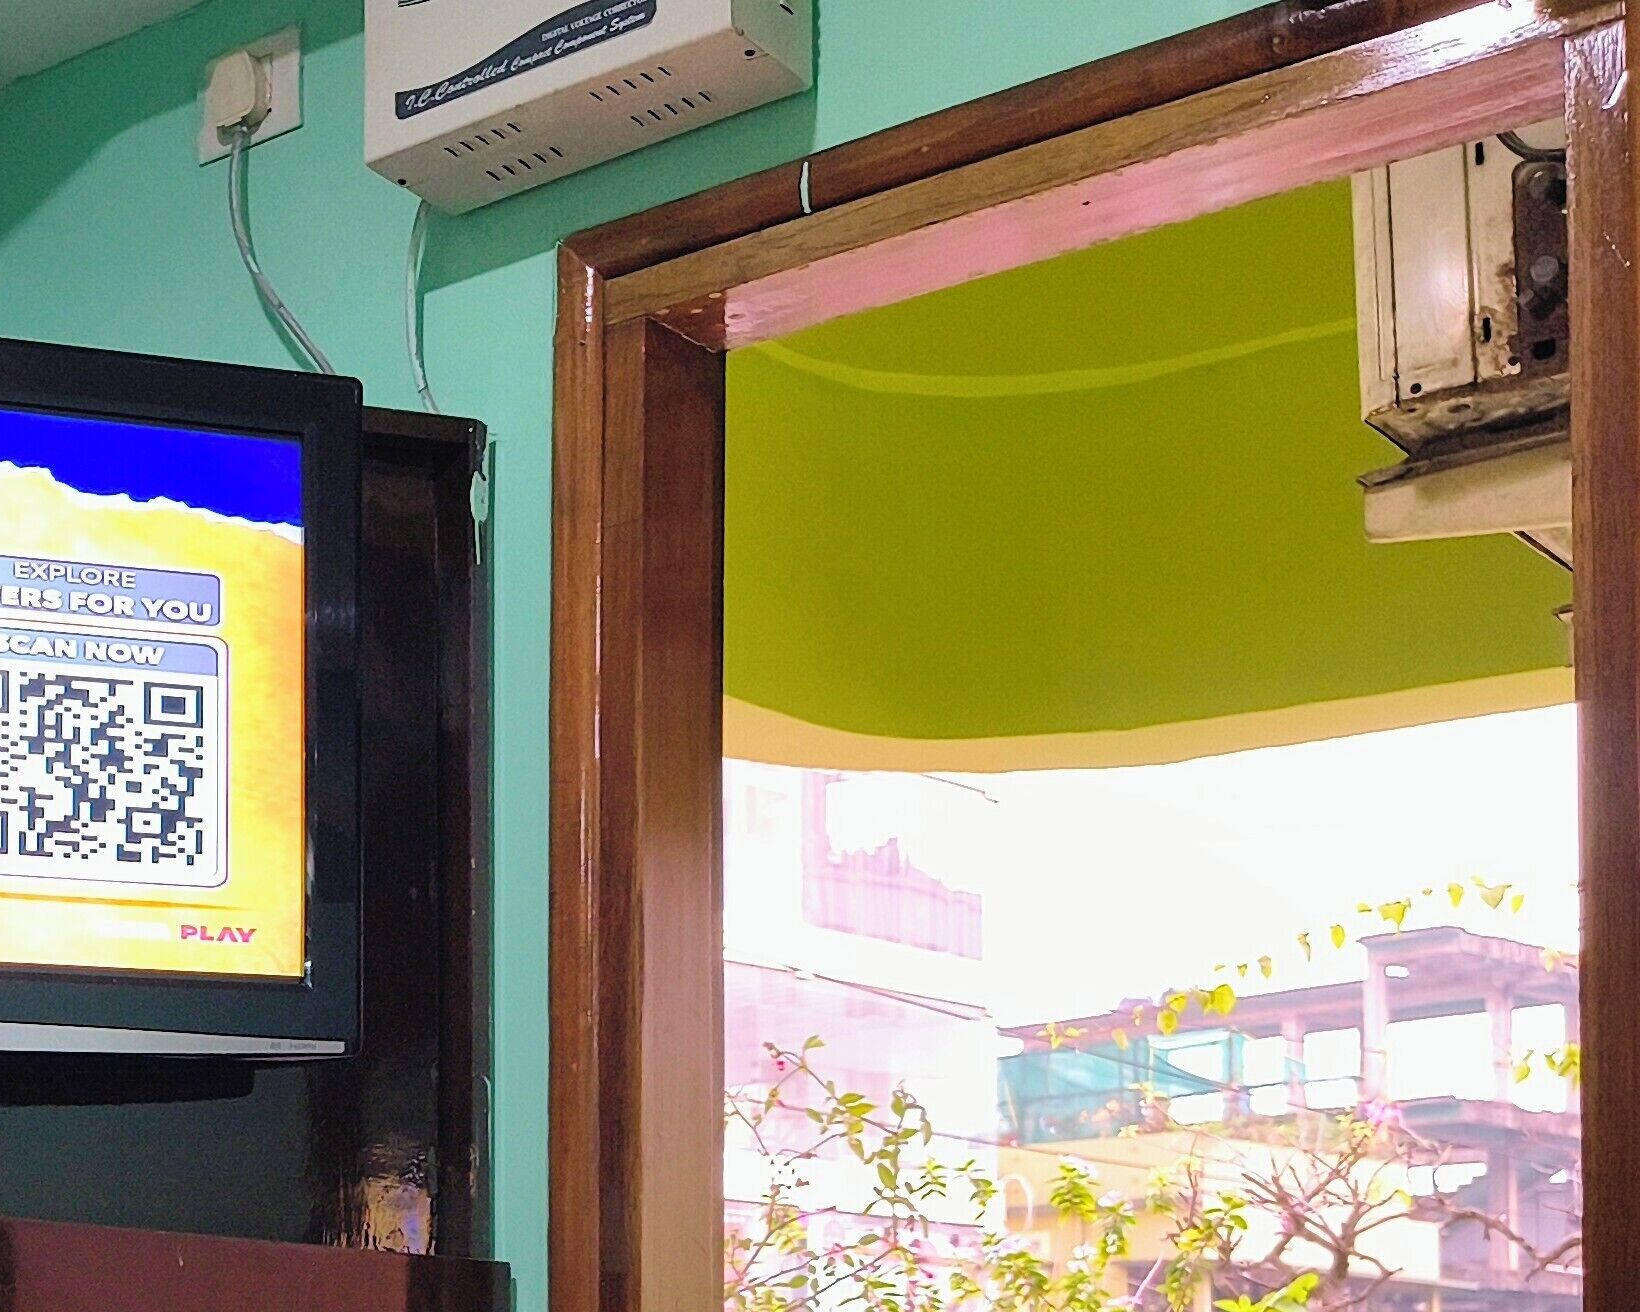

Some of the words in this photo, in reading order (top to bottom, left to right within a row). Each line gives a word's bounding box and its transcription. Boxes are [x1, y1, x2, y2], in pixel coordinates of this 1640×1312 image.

[609, 12, 646, 31] System
[13, 561, 136, 588] EXPLORE
[68, 591, 135, 616] FOR
[141, 598, 213, 623] YOU
[84, 639, 166, 665] NOW
[180, 924, 257, 944] PLAY
